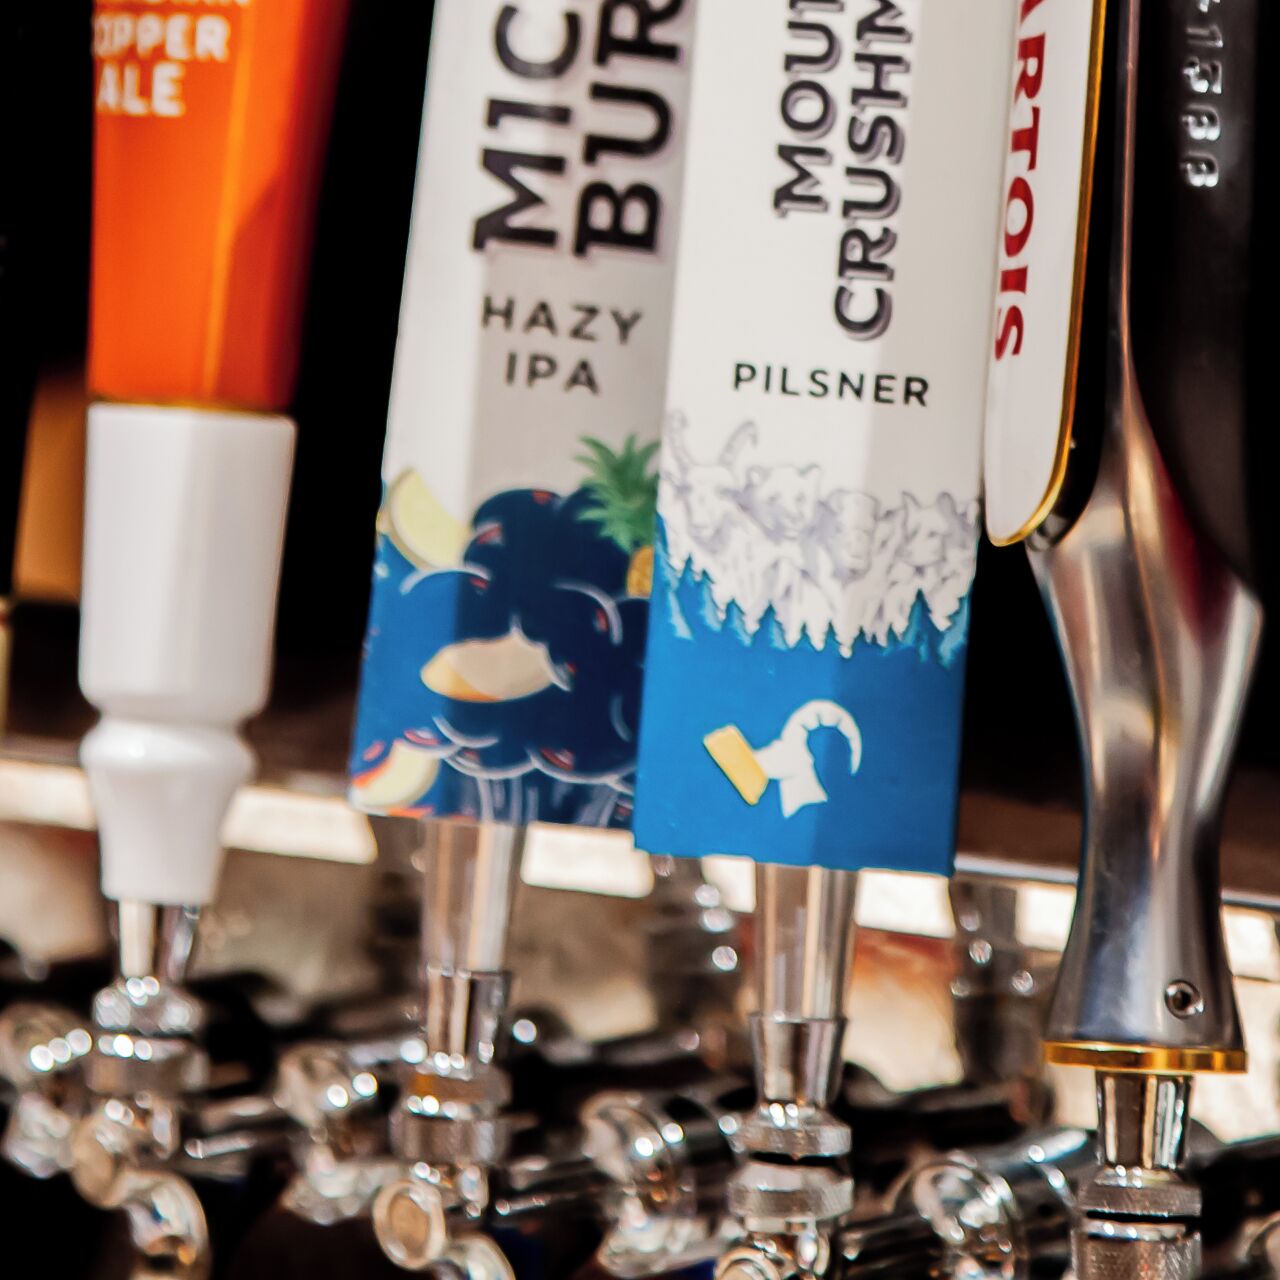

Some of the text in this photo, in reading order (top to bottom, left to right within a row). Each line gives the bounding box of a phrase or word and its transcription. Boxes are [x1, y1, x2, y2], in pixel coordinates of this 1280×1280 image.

[96, 60, 185, 118] ALE
[480, 295, 643, 346] HAZY
[505, 351, 600, 396] IPA
[732, 362, 931, 408] PILSNER
